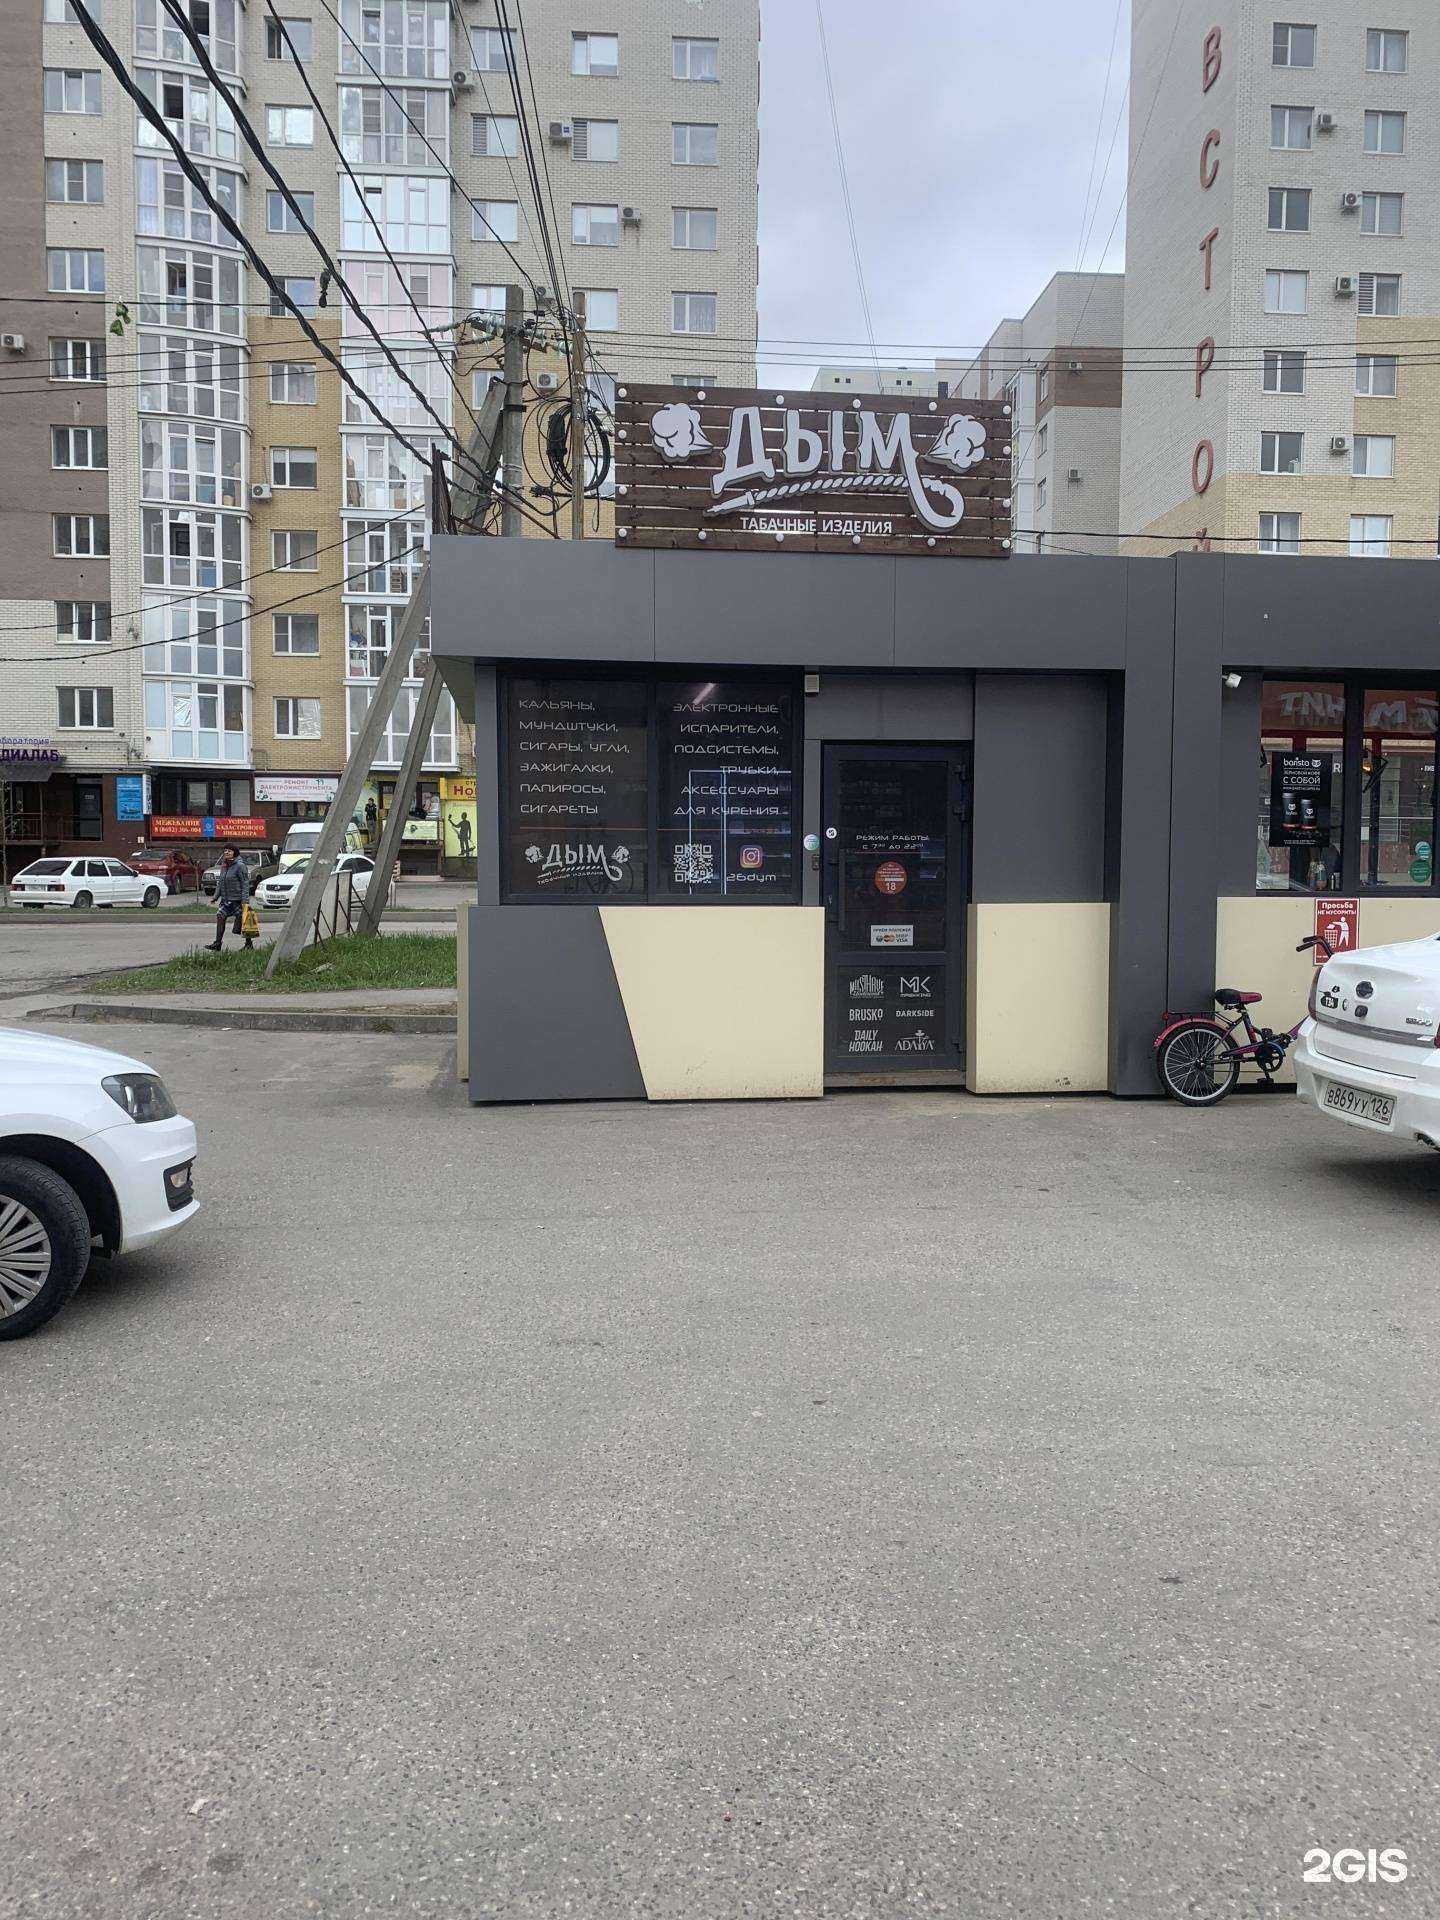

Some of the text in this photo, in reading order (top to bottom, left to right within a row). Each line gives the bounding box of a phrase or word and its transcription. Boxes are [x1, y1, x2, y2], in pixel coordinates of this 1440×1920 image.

[711, 406, 964, 529] ДЫМ
[739, 516, 893, 535] ТАБАЧНЫЕ ИЗДЕЛИЯ
[519, 699, 595, 711] КАЛЬЯНЫ,
[673, 703, 780, 713] ЭЛЕКТРОННЫЕ
[519, 720, 619, 733] МУНДШТУКИ,
[680, 724, 779, 734] ИСПАРИТЕЛИ,
[519, 741, 630, 753] СИГАРЫ, УГЛИ,
[674, 744, 779, 755] ПОДСИСТЕМЫ,
[520, 763, 614, 774] ЗАЖИГАЛКИ,
[1290, 775, 1321, 784] СОБОЙ
[520, 783, 607, 795] ПАПИРОСЫ,
[681, 786, 779, 795] АКСЕССУАРЫ
[520, 804, 598, 814] СИГАРЕТЫ
[673, 806, 779, 816] ДЛЯ КУРЕНИЯ
[542, 844, 623, 881] ДЫМ
[726, 873, 777, 883] 26dym
[1321, 901, 1354, 909] Просьба
[849, 1008, 884, 1021] BRUSKO
[895, 1009, 935, 1017] DARKSIDE
[854, 1029, 879, 1041] DAILY
[848, 1040, 884, 1052] HOOKAH
